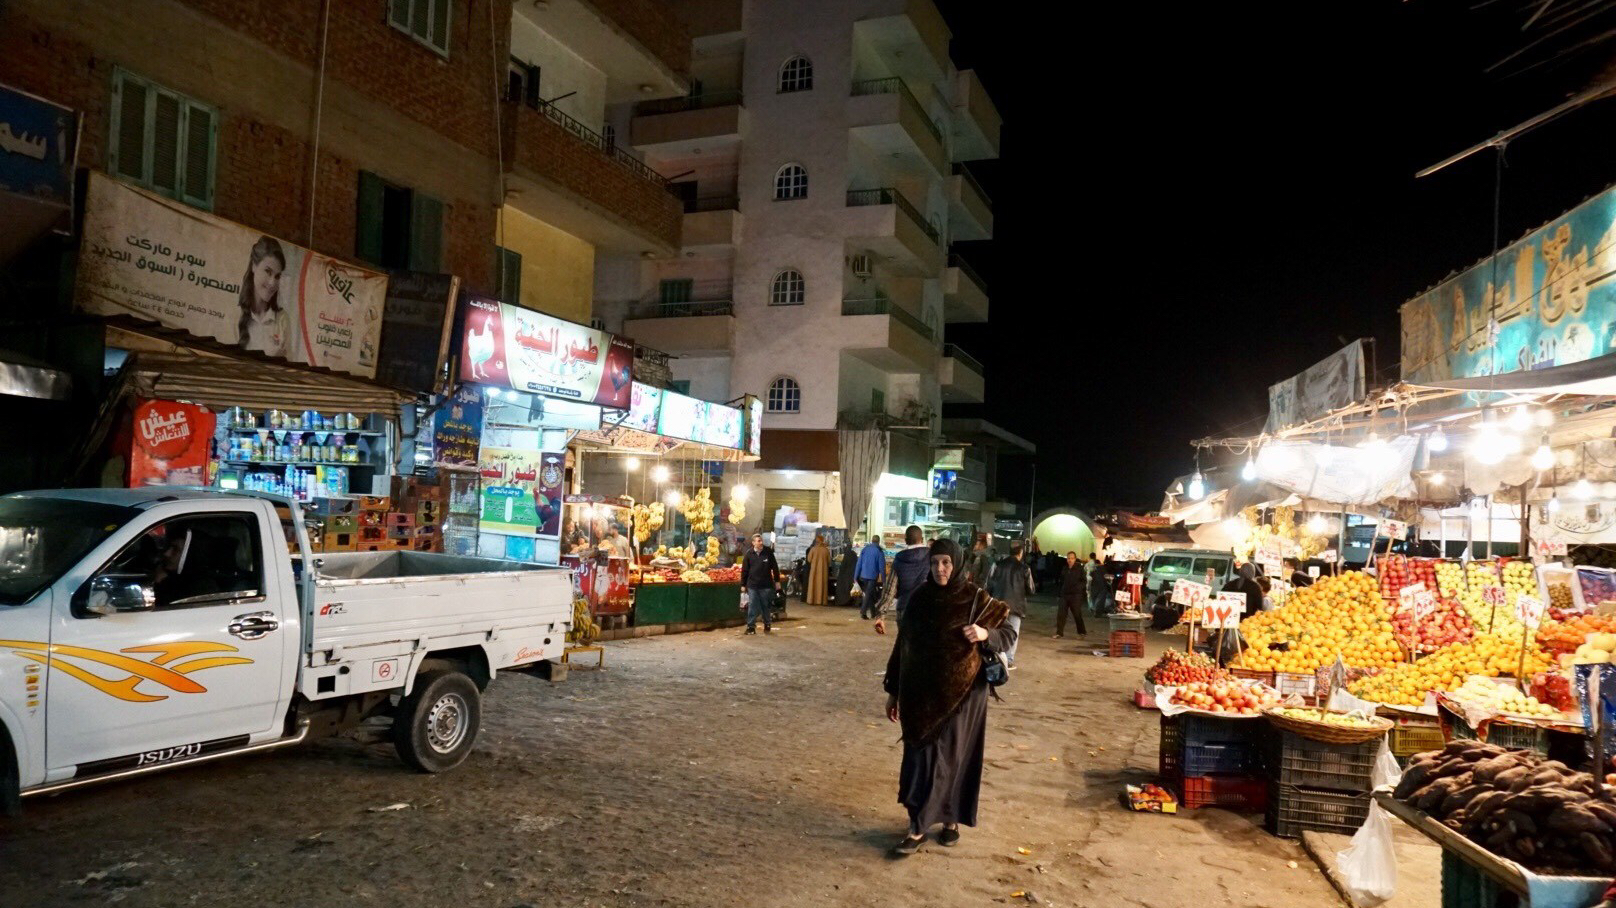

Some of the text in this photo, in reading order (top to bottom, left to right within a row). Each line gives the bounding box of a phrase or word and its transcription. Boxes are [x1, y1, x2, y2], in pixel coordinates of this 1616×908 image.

[126, 235, 206, 267] سوبر ماركت
[135, 255, 177, 276] السوق
[187, 270, 240, 294] المنصورة
[560, 336, 599, 370] طيور
[140, 409, 187, 439] عيش
[508, 463, 537, 485] طيور
[1204, 605, 1232, 625] ١٧
[137, 742, 202, 766] ISUZU
